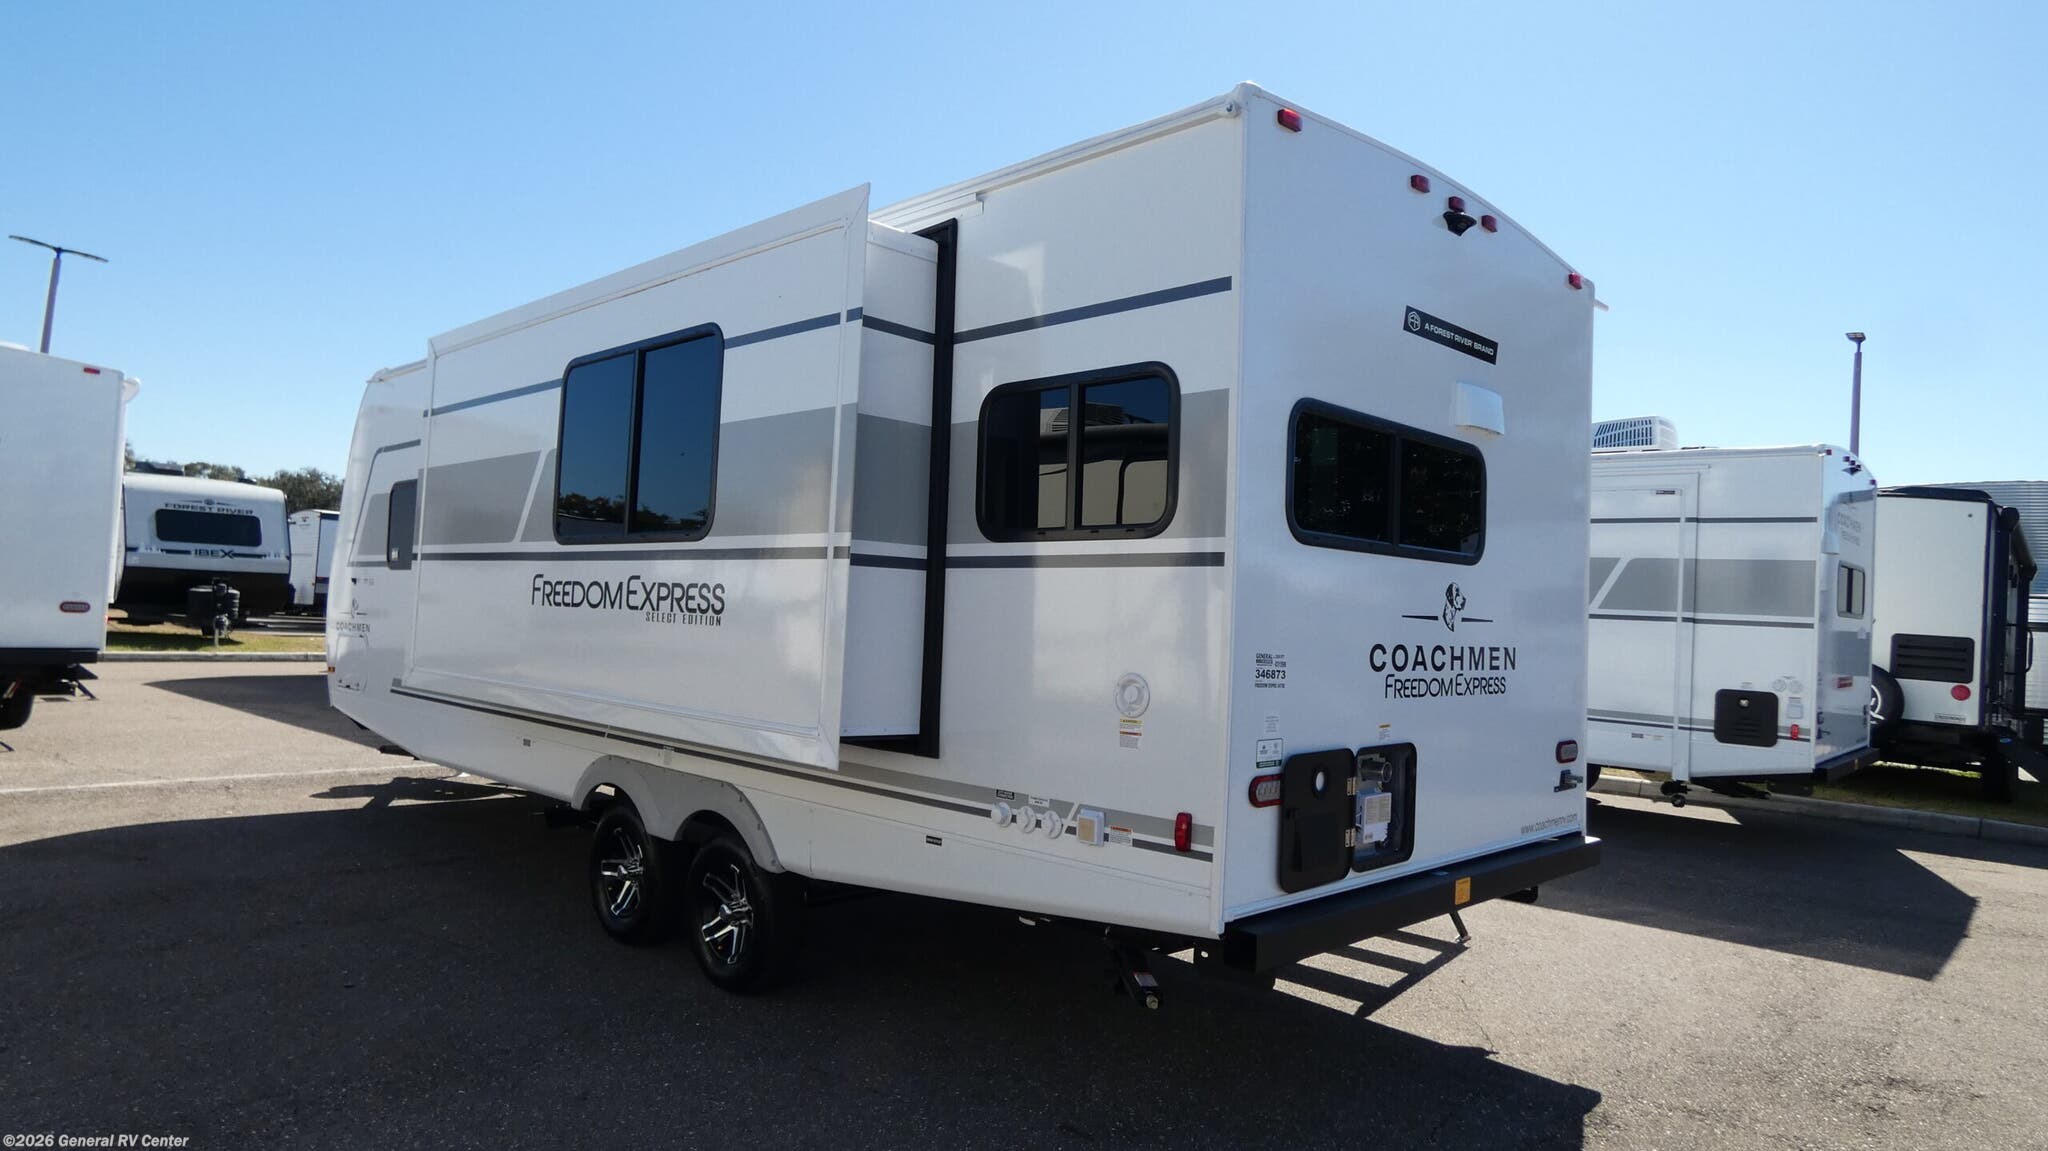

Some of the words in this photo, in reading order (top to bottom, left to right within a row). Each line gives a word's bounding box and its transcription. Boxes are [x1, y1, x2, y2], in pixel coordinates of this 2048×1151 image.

[1430, 325, 1454, 341] FOREST
[1454, 334, 1473, 347] RIVER
[1473, 342, 1494, 356] BRAND
[164, 503, 214, 513] FOREST
[216, 507, 254, 515] RIVER
[194, 548, 234, 559] IBEX
[532, 574, 624, 610] FREEDOM
[626, 575, 725, 616] EXPRESS
[336, 621, 371, 633] COACHMEN
[645, 611, 677, 624] SELECT
[682, 613, 722, 627] EDITION
[1369, 643, 1516, 673] COACHMEN
[1255, 669, 1287, 680] 346873
[1385, 674, 1453, 699] FREEDOM
[1455, 673, 1506, 696] EXPRESS
